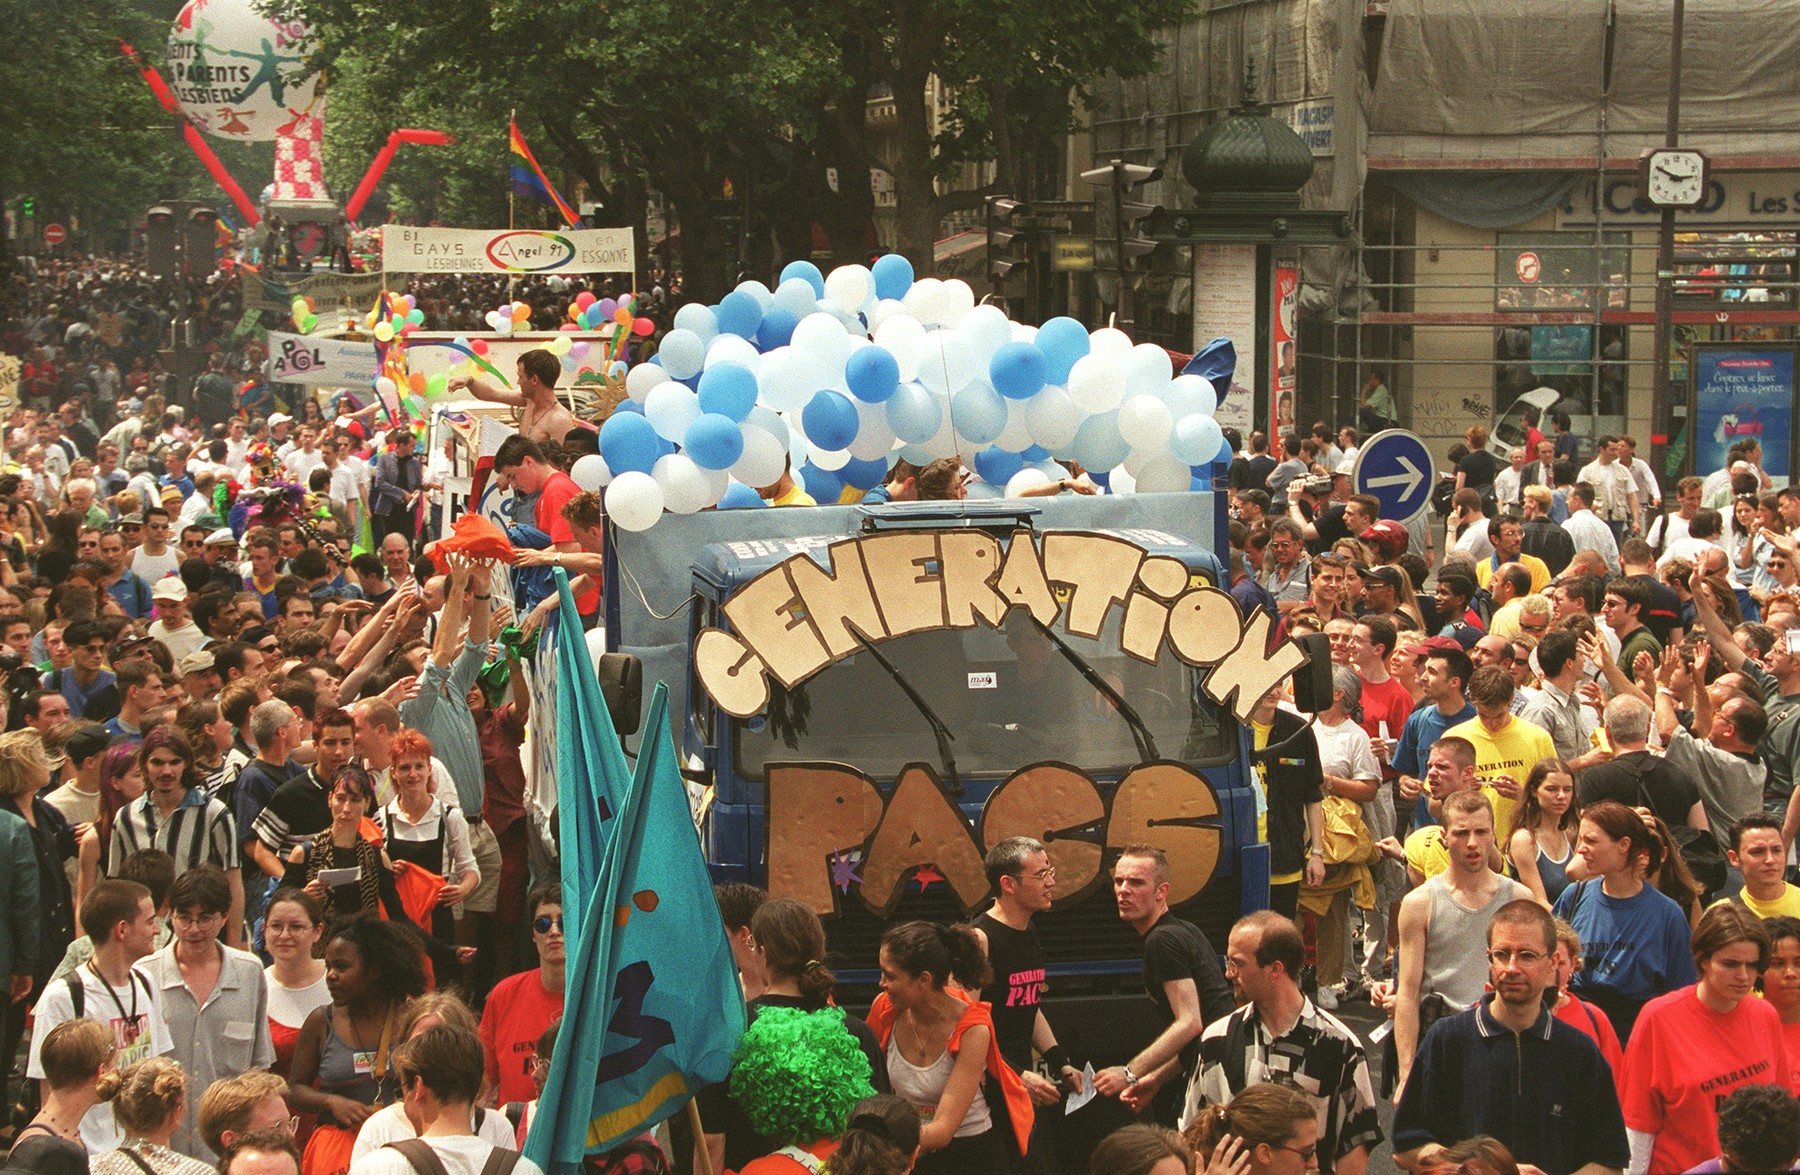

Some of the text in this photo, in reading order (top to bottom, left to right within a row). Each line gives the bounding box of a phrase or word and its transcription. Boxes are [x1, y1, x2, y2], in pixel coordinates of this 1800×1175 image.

[177, 63, 250, 83] PARENTS
[1749, 191, 1788, 213] Les
[403, 230, 419, 241] BI
[596, 235, 614, 246] en
[413, 243, 464, 255] GAYS
[498, 240, 542, 262] Angel
[582, 248, 628, 264] ESSONNE
[426, 257, 484, 271] LESBIENNES
[763, 759, 1224, 920] PACS
[1700, 1060, 1770, 1093] GENERATION
